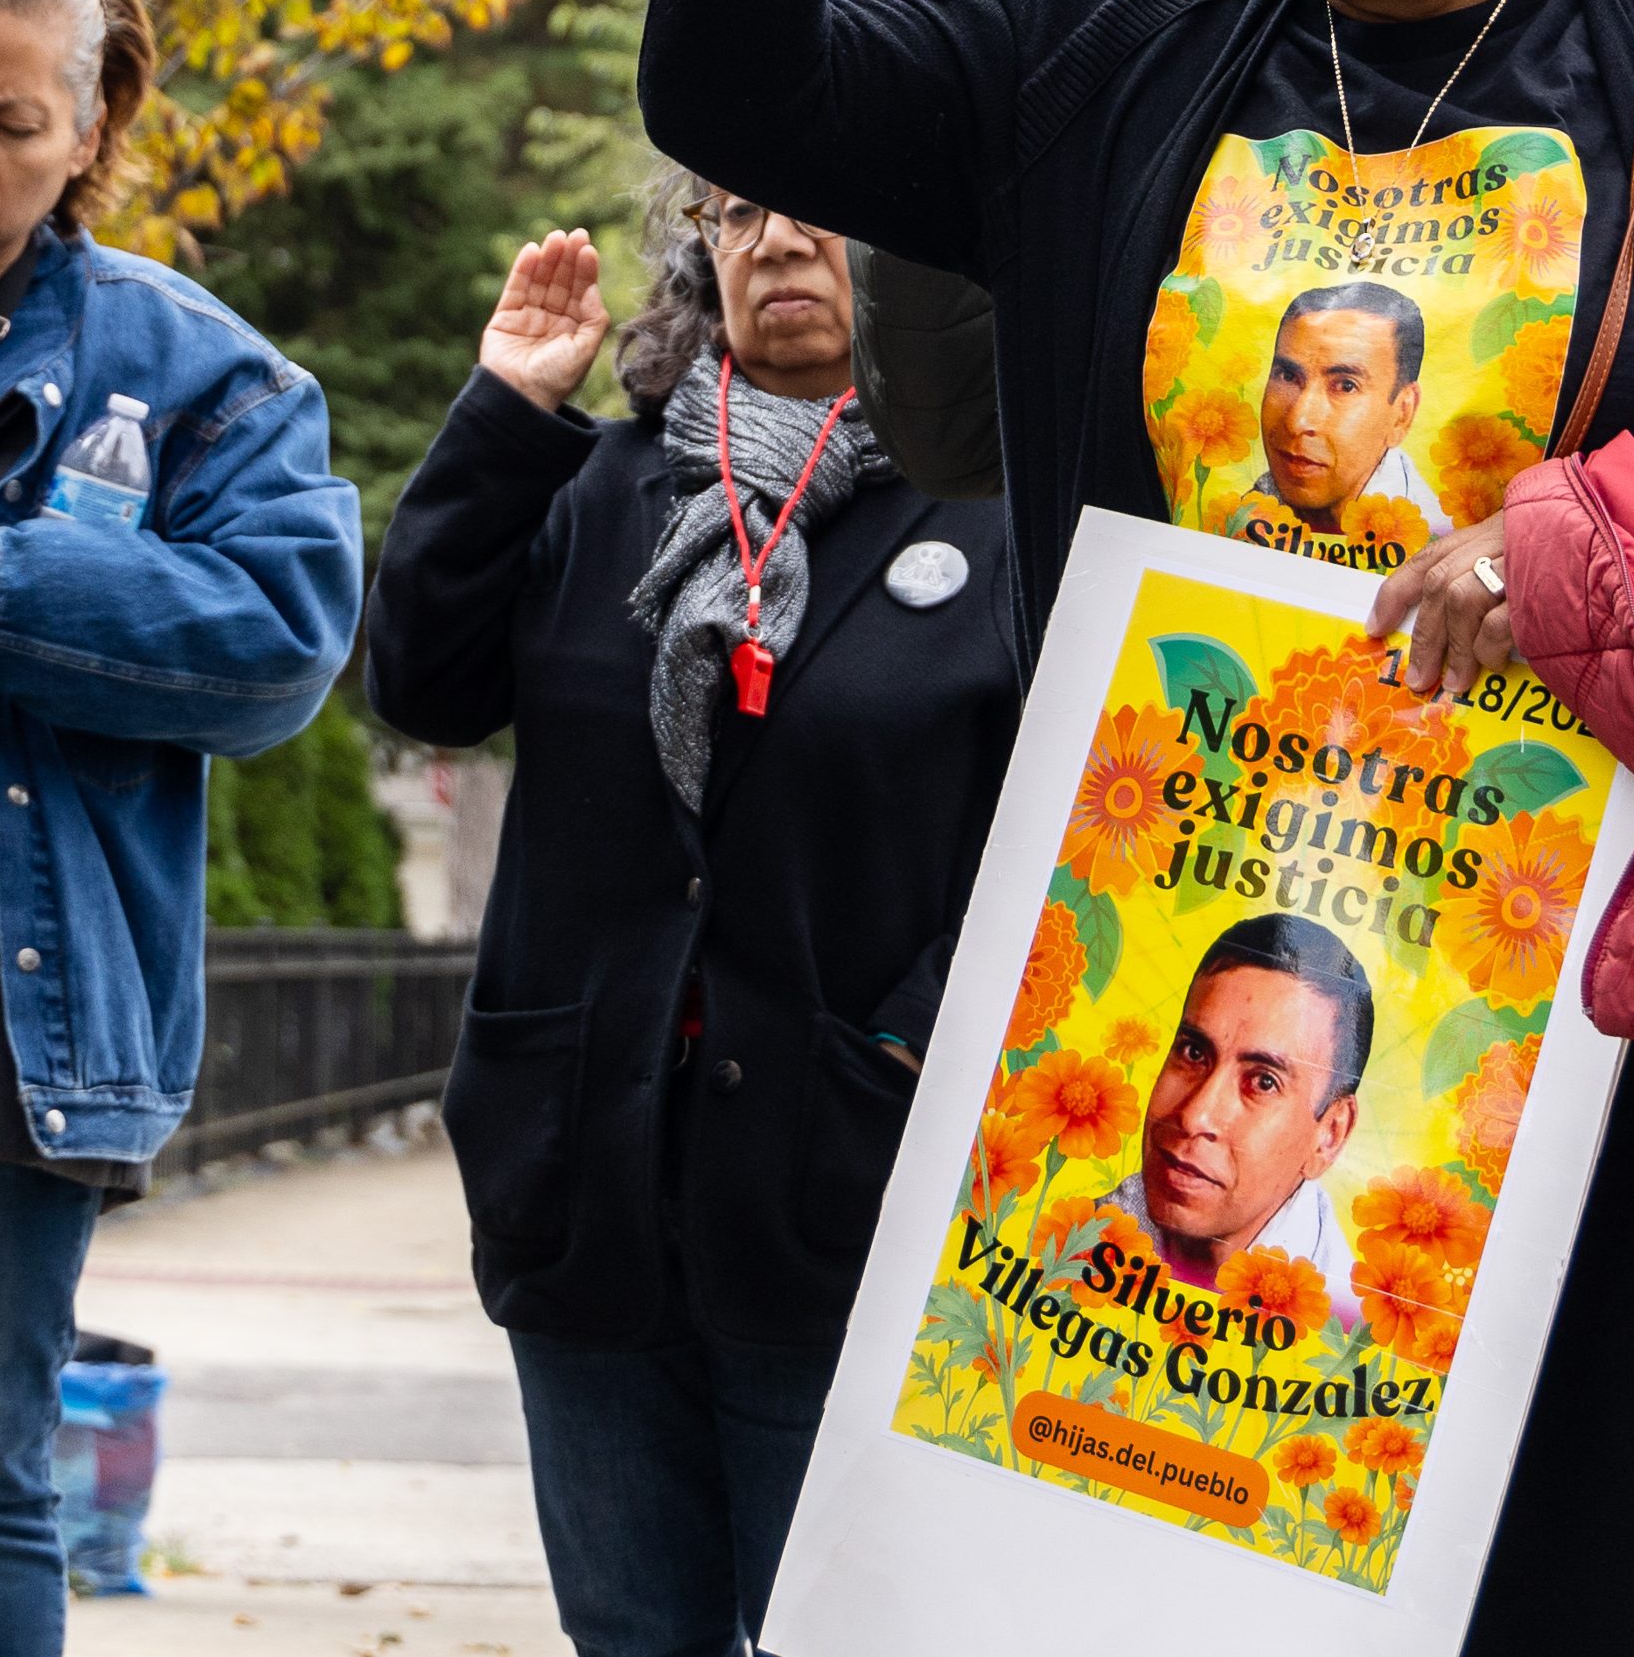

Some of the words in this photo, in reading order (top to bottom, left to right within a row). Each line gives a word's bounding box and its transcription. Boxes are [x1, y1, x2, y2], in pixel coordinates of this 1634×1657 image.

[1259, 199, 1500, 248] exigimos
[1270, 153, 1509, 209] Nosotras
[1176, 688, 1505, 826] Nosotras
[1154, 819, 1441, 949] justicia
[1162, 763, 1483, 891] exigimos
[957, 1214, 1153, 1379] Villegas
[1165, 1342, 1435, 1419] Gonzalez
[1080, 1240, 1297, 1352] Silverio
[1027, 1414, 1250, 1507] @hijas.del.pueblo
